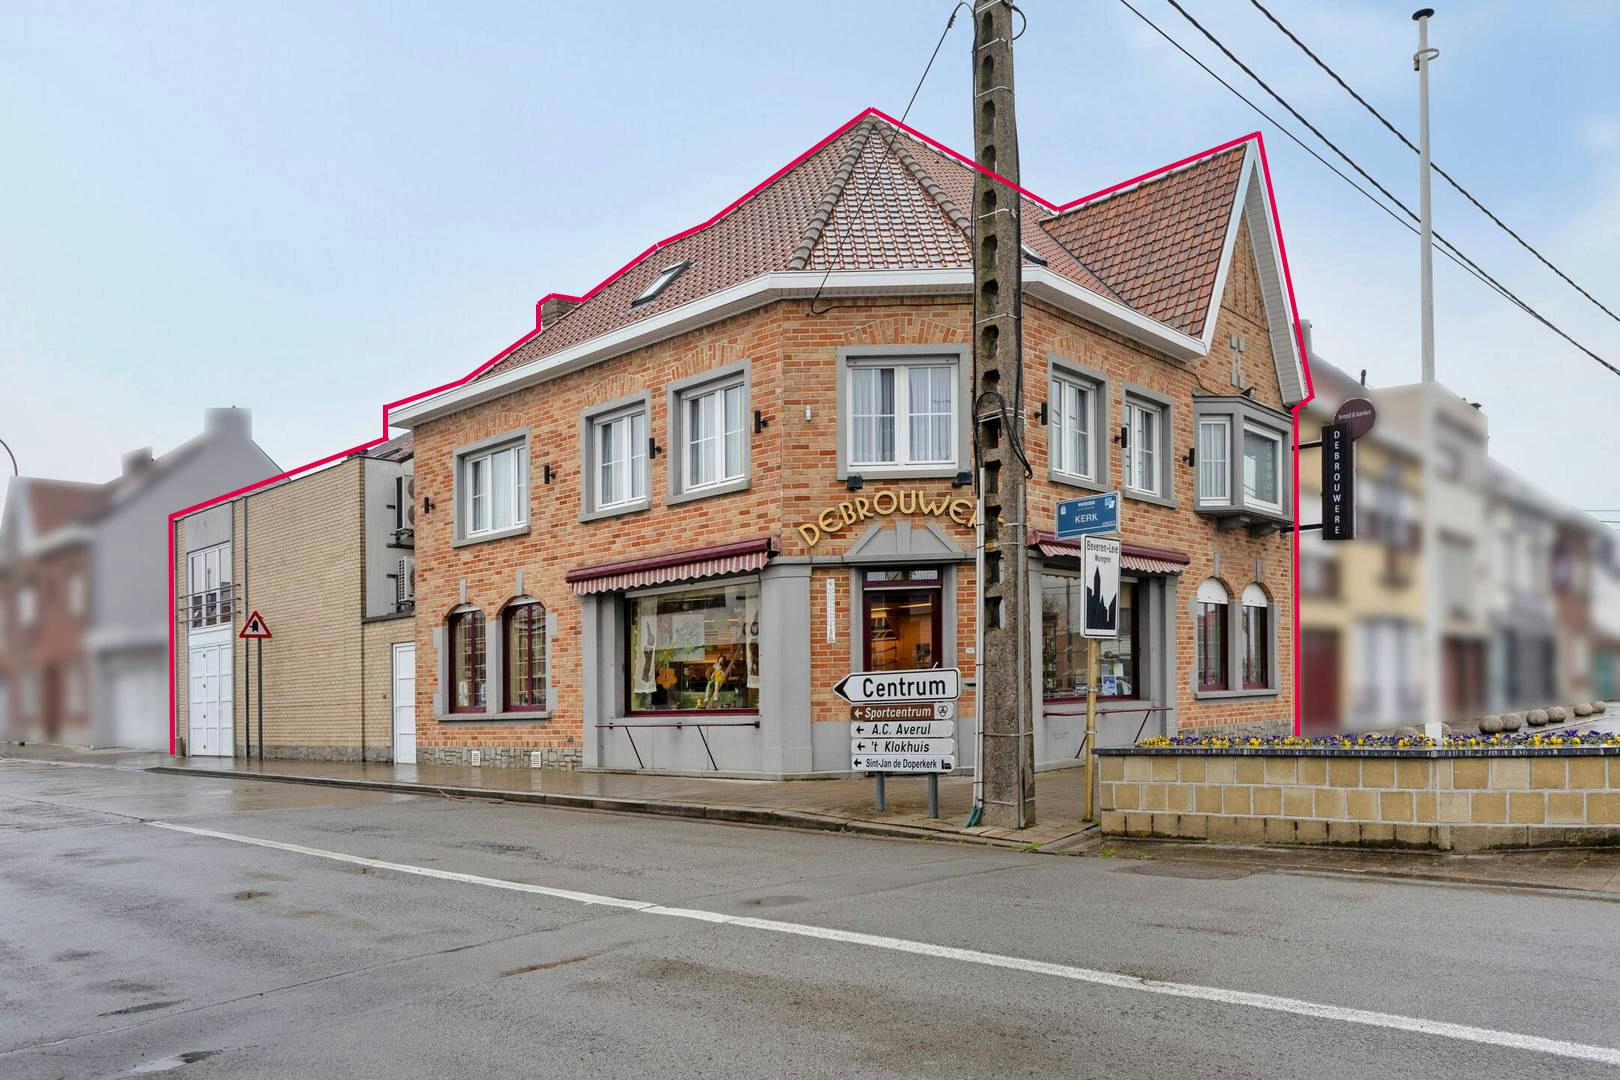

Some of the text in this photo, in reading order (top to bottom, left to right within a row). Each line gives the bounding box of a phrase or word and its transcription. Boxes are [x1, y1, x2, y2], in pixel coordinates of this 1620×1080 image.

[1333, 431, 1341, 534] DEBROUWERE
[798, 490, 1004, 547] DEBROUWE
[1075, 513, 1098, 523] KERK
[1087, 540, 1119, 554] Beveren-Leie
[863, 677, 946, 698] Centrum
[865, 707, 931, 720] Sportcentrum
[872, 723, 931, 735] A.C. Averul
[871, 741, 930, 752] 't Klokhuis
[866, 758, 937, 770] Sint-Jan de Doperkerk
